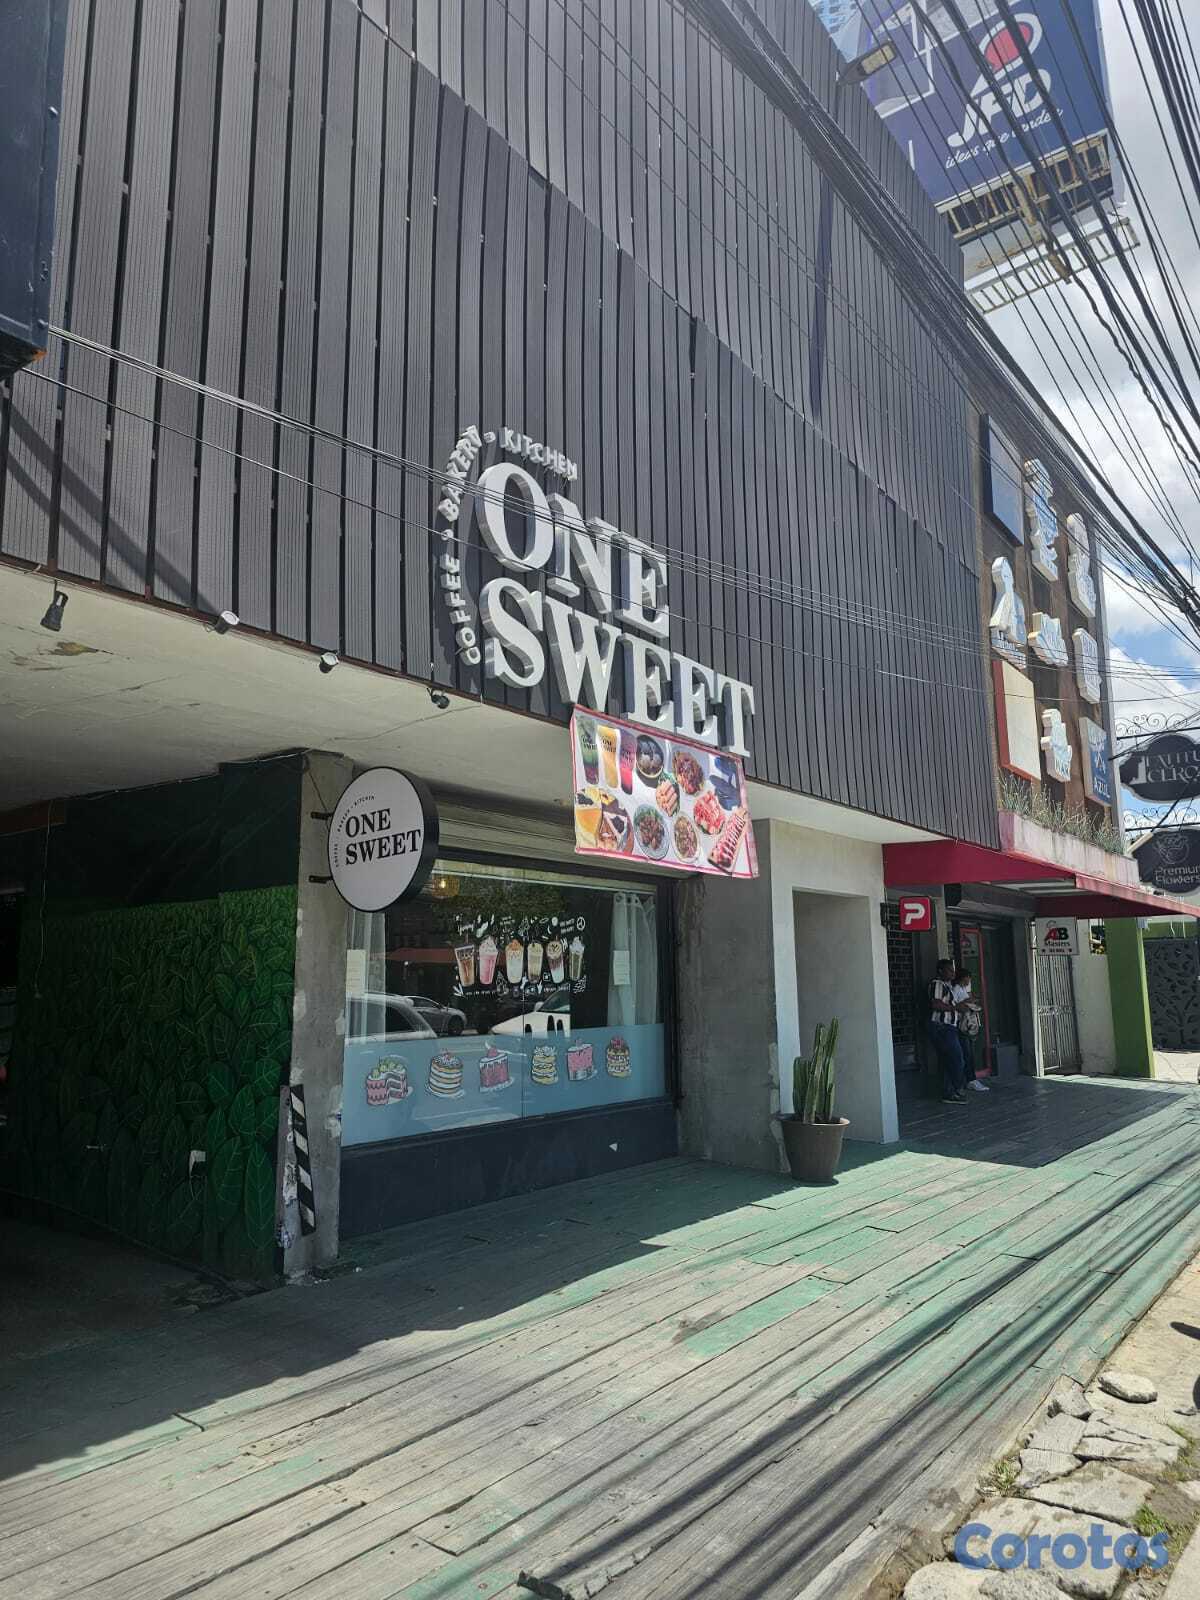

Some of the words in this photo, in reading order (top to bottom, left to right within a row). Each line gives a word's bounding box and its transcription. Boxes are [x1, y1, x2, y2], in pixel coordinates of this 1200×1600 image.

[437, 423, 483, 523] BAKERY
[500, 425, 578, 482] KITCHEN
[474, 461, 669, 639] ONE
[439, 550, 482, 667] COFFEE
[477, 576, 755, 758] SWEET
[345, 808, 391, 838] ONE
[345, 829, 422, 866] SWEET
